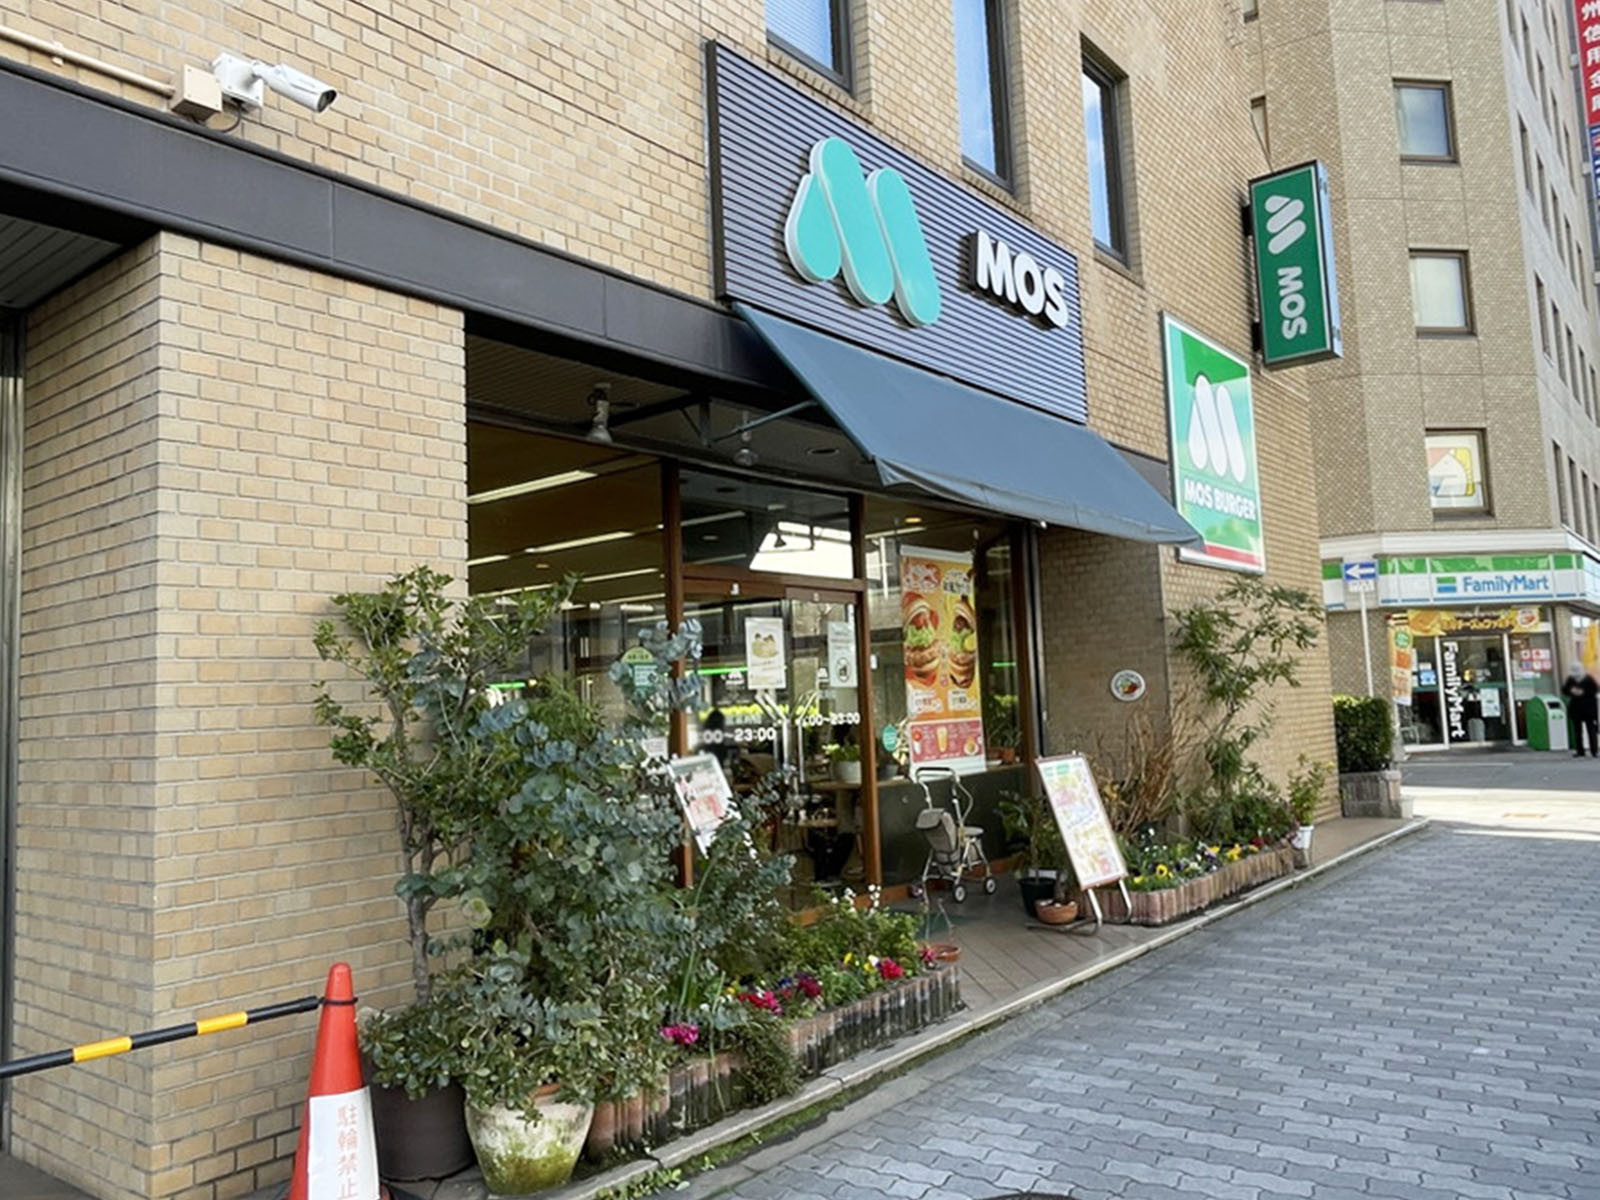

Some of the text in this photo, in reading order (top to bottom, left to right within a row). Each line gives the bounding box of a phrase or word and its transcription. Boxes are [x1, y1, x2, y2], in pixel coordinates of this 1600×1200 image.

[977, 230, 1069, 328] MOS
[1277, 266, 1307, 339] MOS
[1184, 478, 1256, 520] MOS BURGER
[1463, 575, 1549, 593] FamilyMart
[1443, 641, 1465, 738] FamilyMart
[337, 1103, 359, 1200] 駐輪禁止
